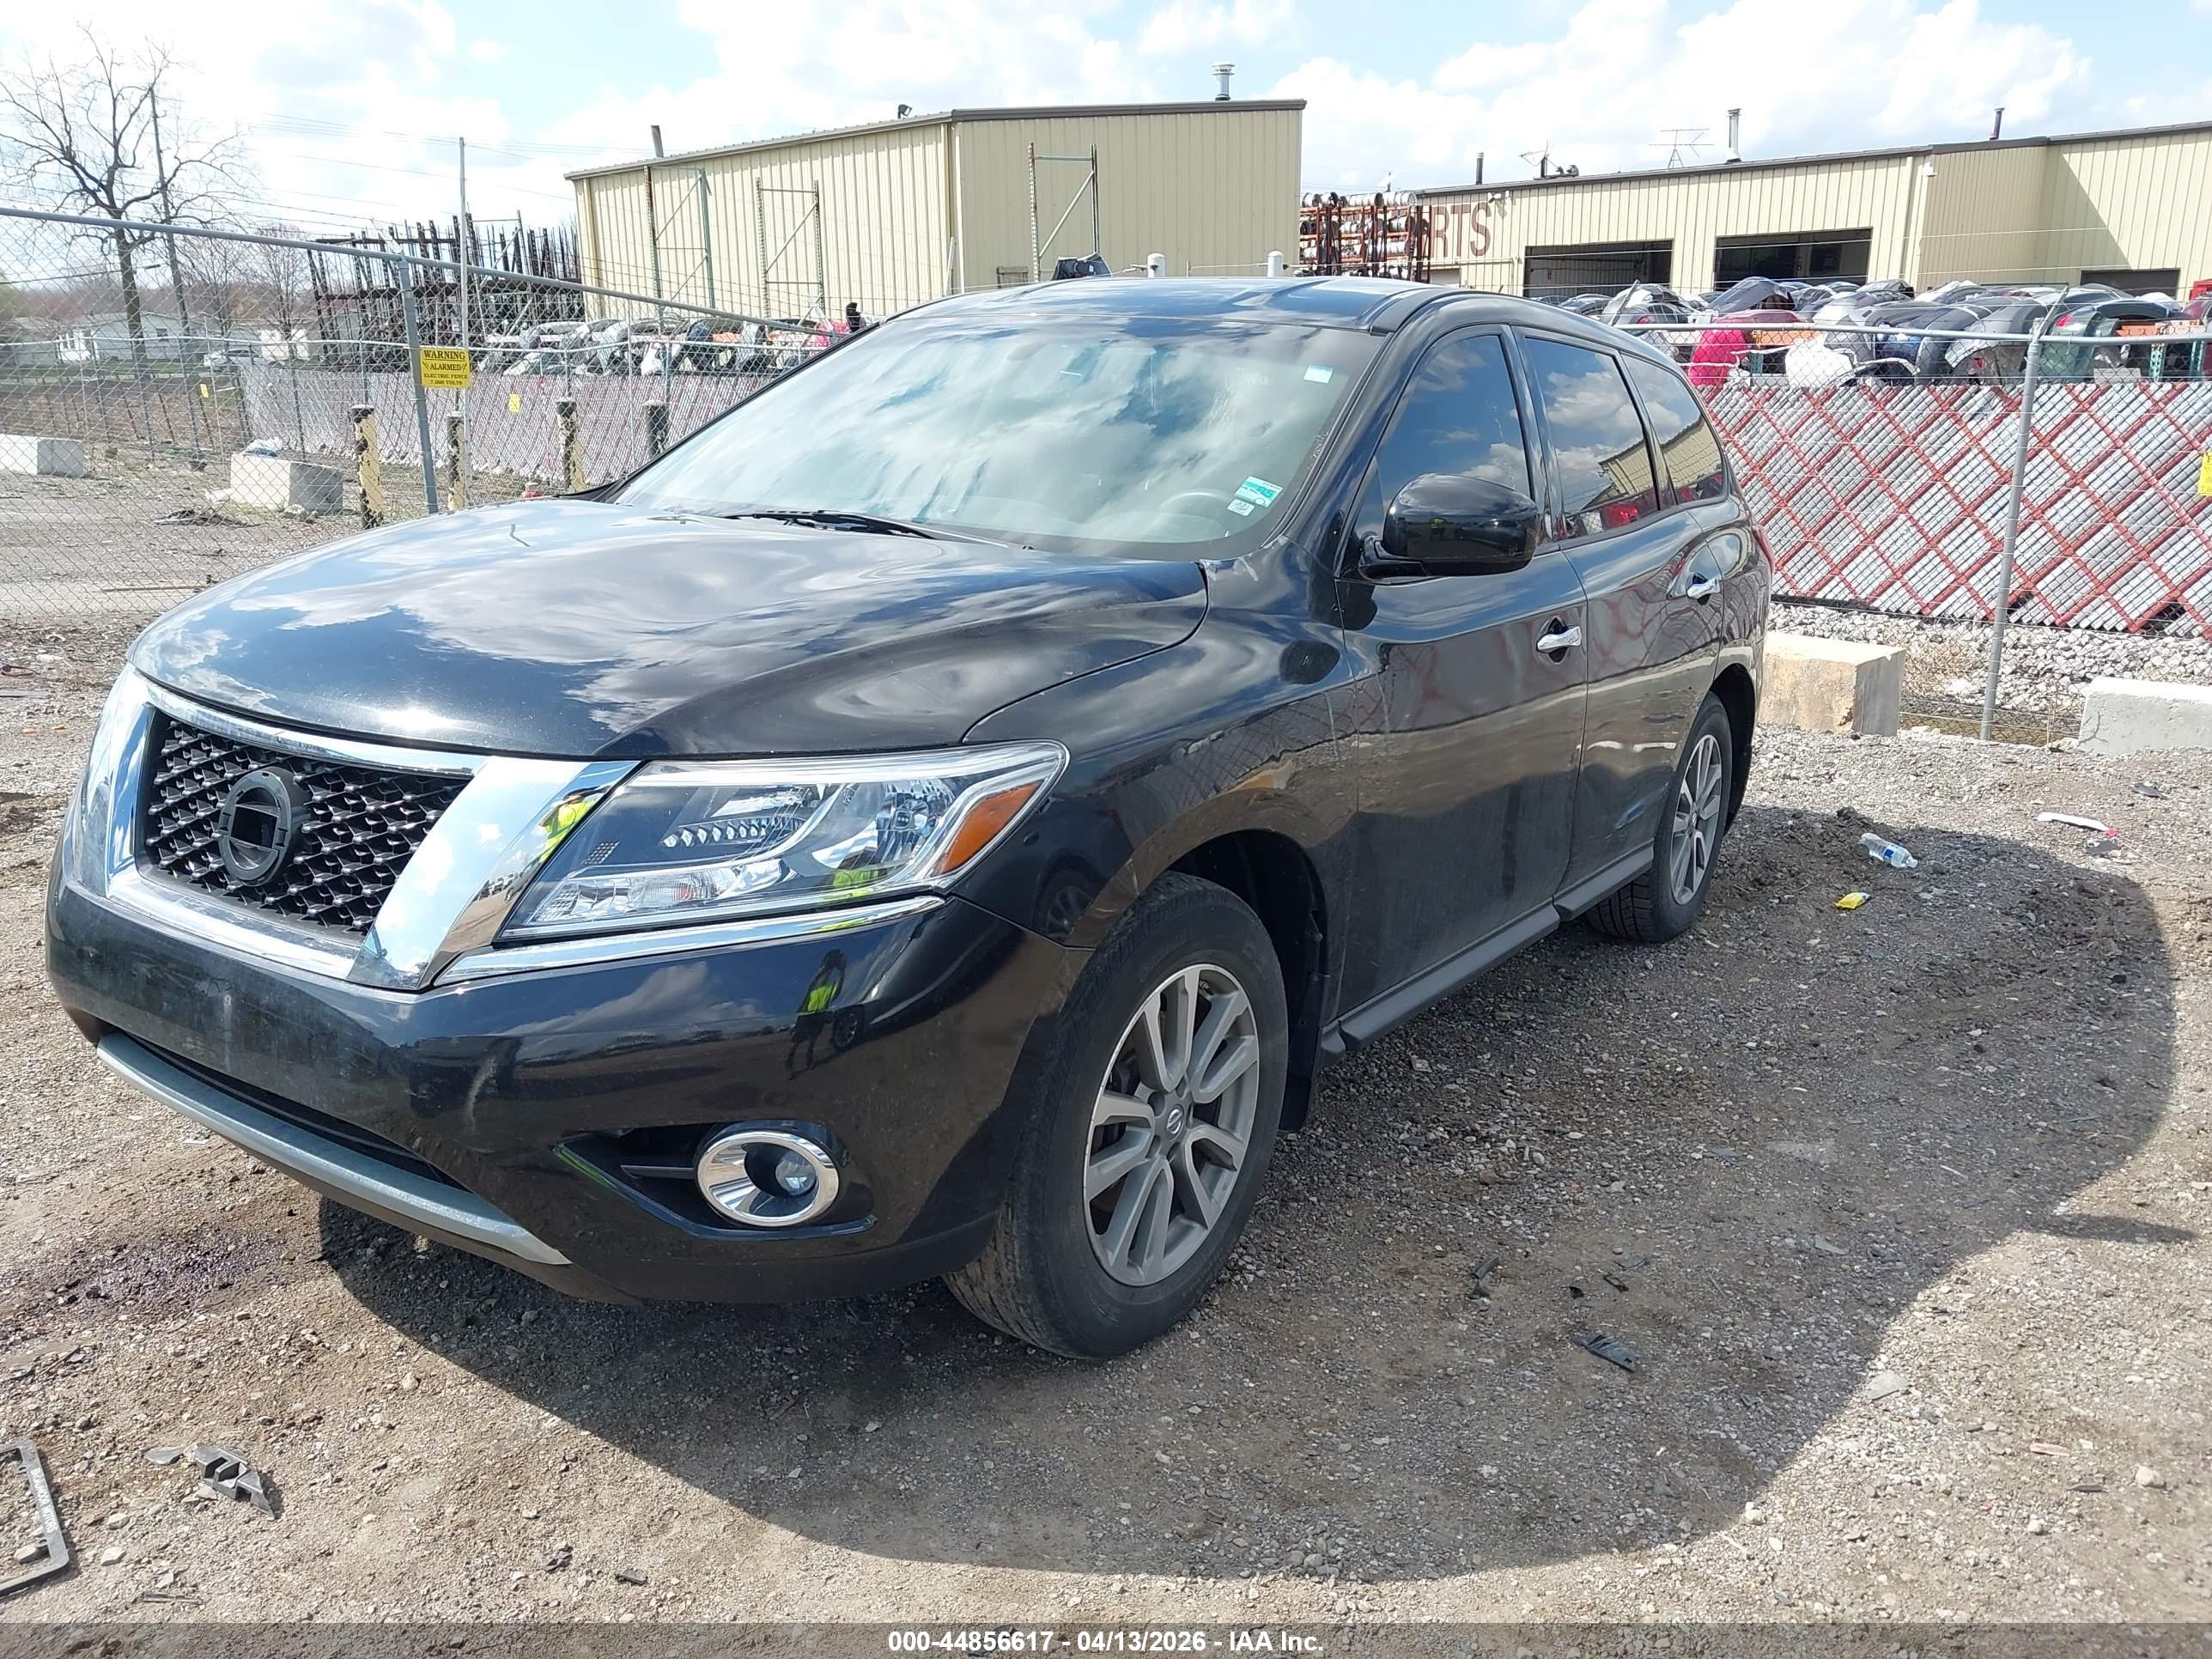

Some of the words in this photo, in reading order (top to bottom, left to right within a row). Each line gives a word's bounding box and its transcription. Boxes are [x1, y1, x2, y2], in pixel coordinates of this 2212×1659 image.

[1422, 202, 1492, 258] RTS
[423, 349, 465, 360] WARNING
[40, 1504, 58, 1534] MOTORS
